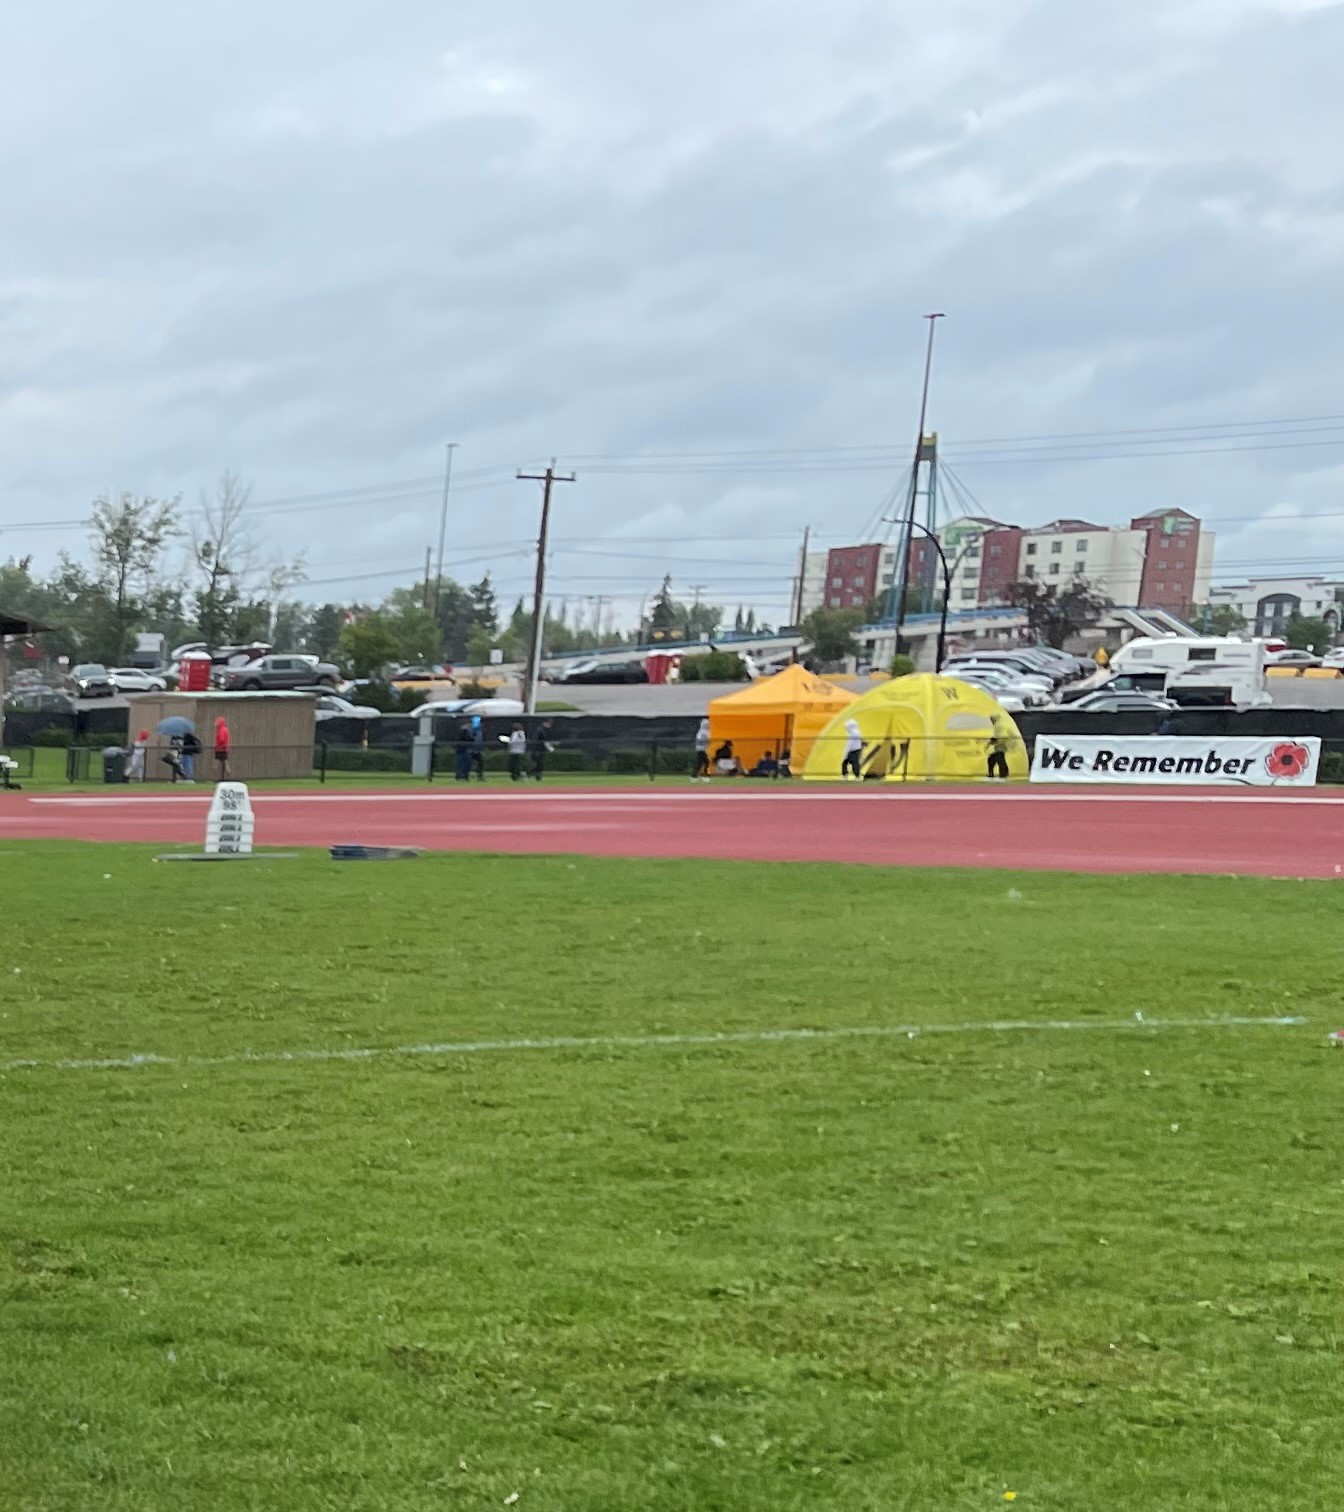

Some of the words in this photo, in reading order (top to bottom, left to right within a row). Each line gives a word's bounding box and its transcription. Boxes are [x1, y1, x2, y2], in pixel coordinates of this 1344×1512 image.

[1040, 747, 1084, 770] We
[1092, 750, 1256, 774] Remember
[220, 788, 245, 800] 30m
